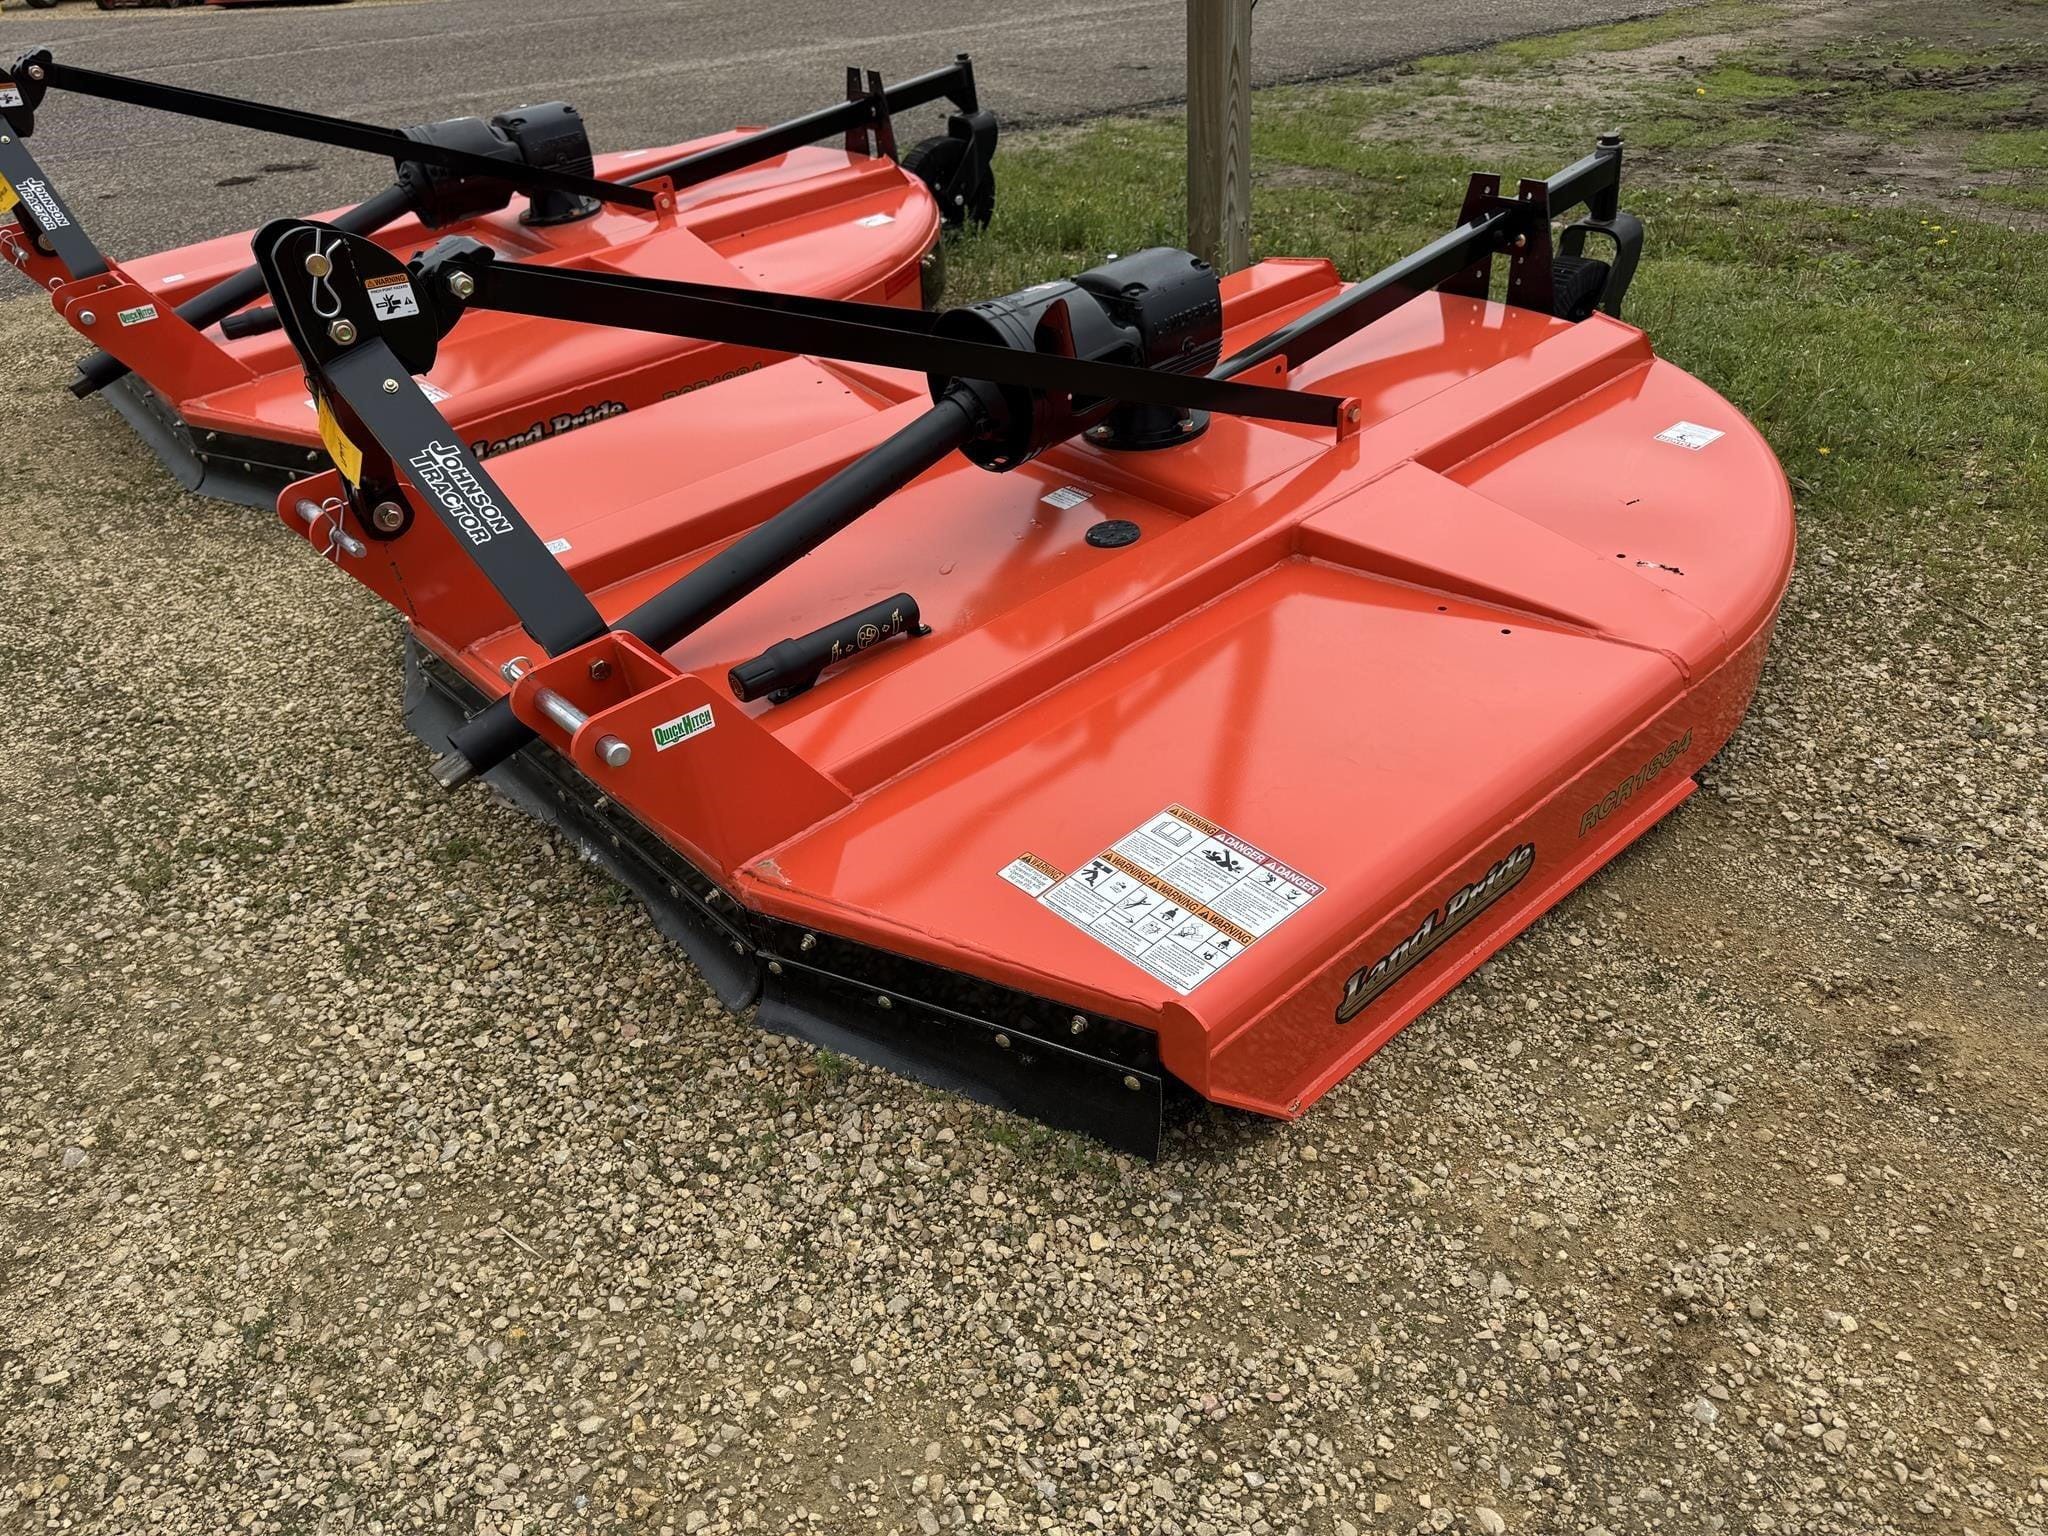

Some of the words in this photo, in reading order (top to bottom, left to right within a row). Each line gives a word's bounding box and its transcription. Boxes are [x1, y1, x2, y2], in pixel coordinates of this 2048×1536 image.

[15, 182, 57, 230] TRACTOR
[27, 177, 71, 227] JOHNSON
[374, 274, 406, 286] WARNING
[409, 449, 492, 546] TRACTOR
[428, 441, 514, 534] JOHNSON
[1578, 727, 1693, 838] RCR1884
[1176, 810, 1218, 835] WARNING
[1222, 836, 1267, 863] DANGER
[1030, 859, 1062, 879] WARNING
[1109, 856, 1151, 882] WARNING
[1273, 865, 1320, 894] DANGER
[1155, 883, 1200, 912] WARNING
[1205, 914, 1253, 944] WARNING
[1336, 908, 1440, 1014] Land
[1442, 842, 1536, 928] Pride
